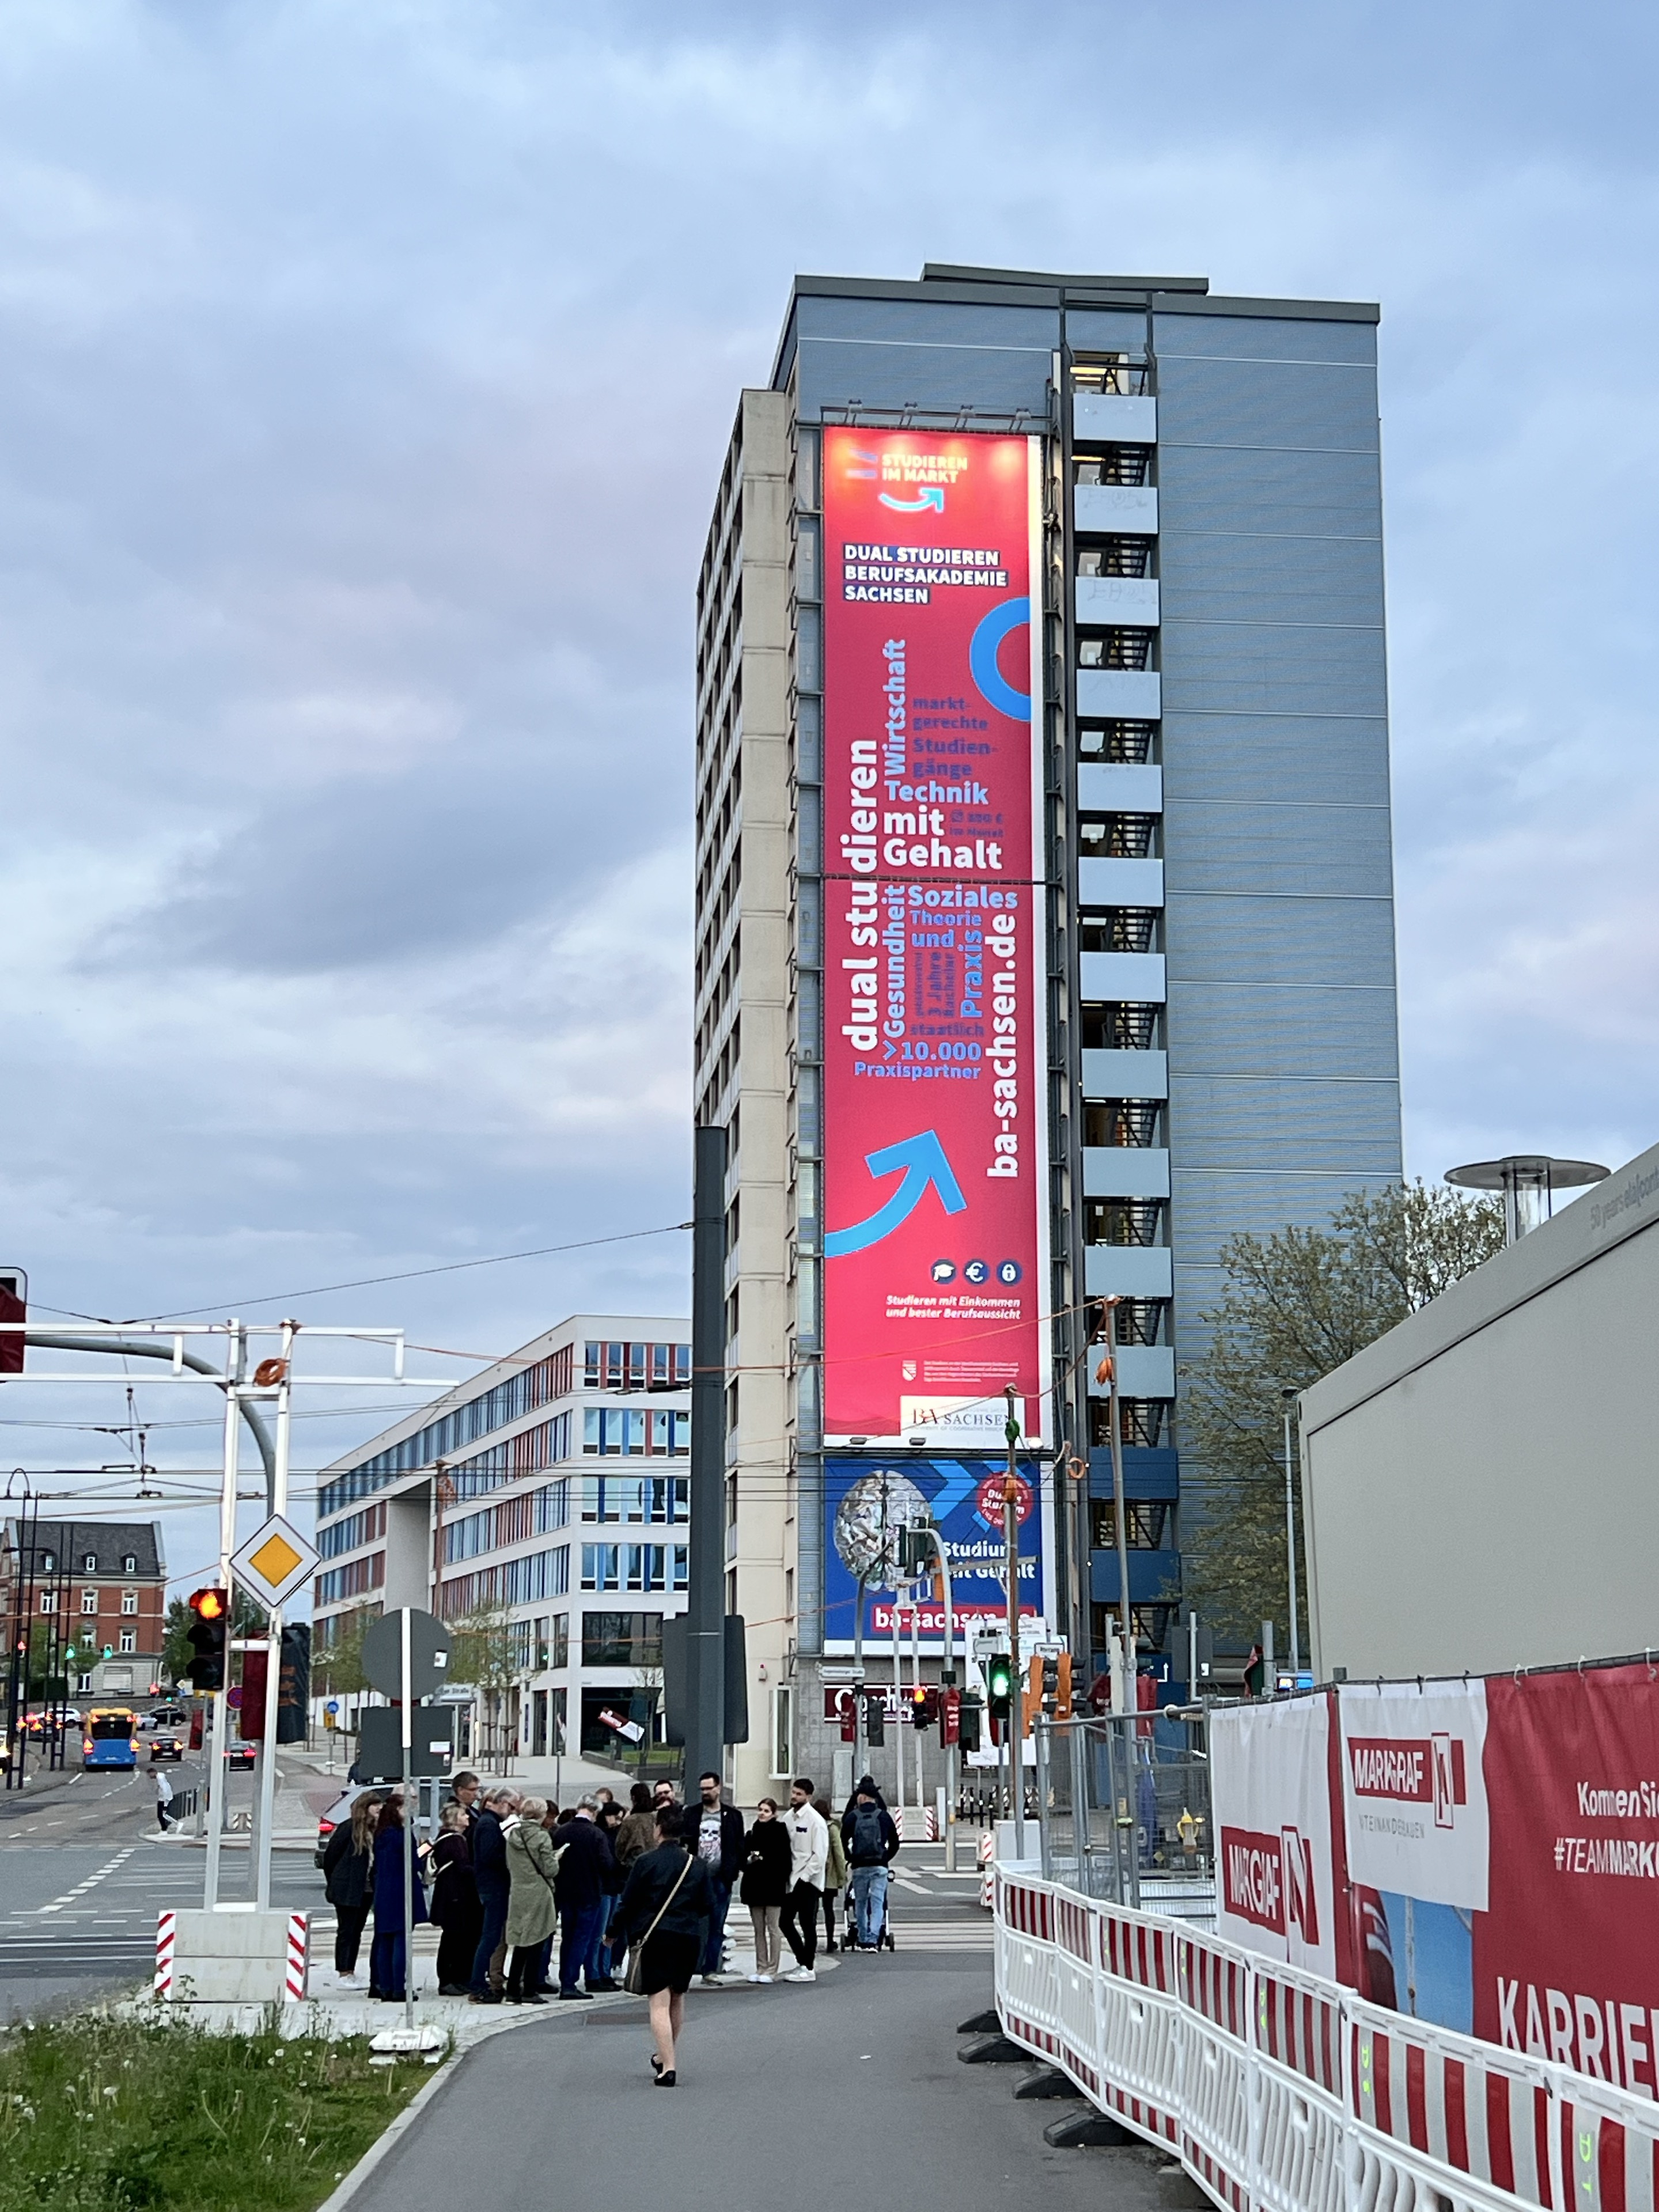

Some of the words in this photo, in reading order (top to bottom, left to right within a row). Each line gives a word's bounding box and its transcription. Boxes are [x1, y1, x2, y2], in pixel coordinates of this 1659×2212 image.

[882, 454, 968, 470] STUDIEREN
[882, 468, 901, 481] IM
[904, 469, 959, 483] MARKT
[844, 545, 893, 561] DUAL
[897, 547, 999, 566] STUDIEREN
[844, 566, 1007, 586] BERUFSAKADEMIE
[844, 586, 929, 604] SACHSEN
[882, 639, 906, 777] Wirtschaft
[912, 717, 988, 731] gerechte
[913, 759, 972, 780] gänge
[884, 780, 988, 804] Technik
[883, 805, 945, 835] mit
[883, 838, 1003, 870] Gehalt
[908, 884, 1018, 909] Soziales
[910, 910, 982, 927] Theorie
[912, 929, 955, 948] und
[882, 885, 905, 1037] Gesundheit
[957, 929, 983, 1018] Praxis
[842, 957, 878, 1051] dual
[910, 1022, 984, 1036] staatlich
[984, 914, 1018, 1177] ba-sachsen.de
[854, 1062, 981, 1081] Praxispartner
[886, 1295, 937, 1306] Studieren
[939, 1296, 957, 1306] mit
[959, 1296, 1021, 1308] Einkommen
[886, 1308, 907, 1317] und
[908, 1308, 942, 1318] bester
[944, 1308, 1021, 1320] Berufsaussicht
[1641, 1781, 1659, 1818] Si
[1554, 1838, 1659, 1878] #TEAMMARK
